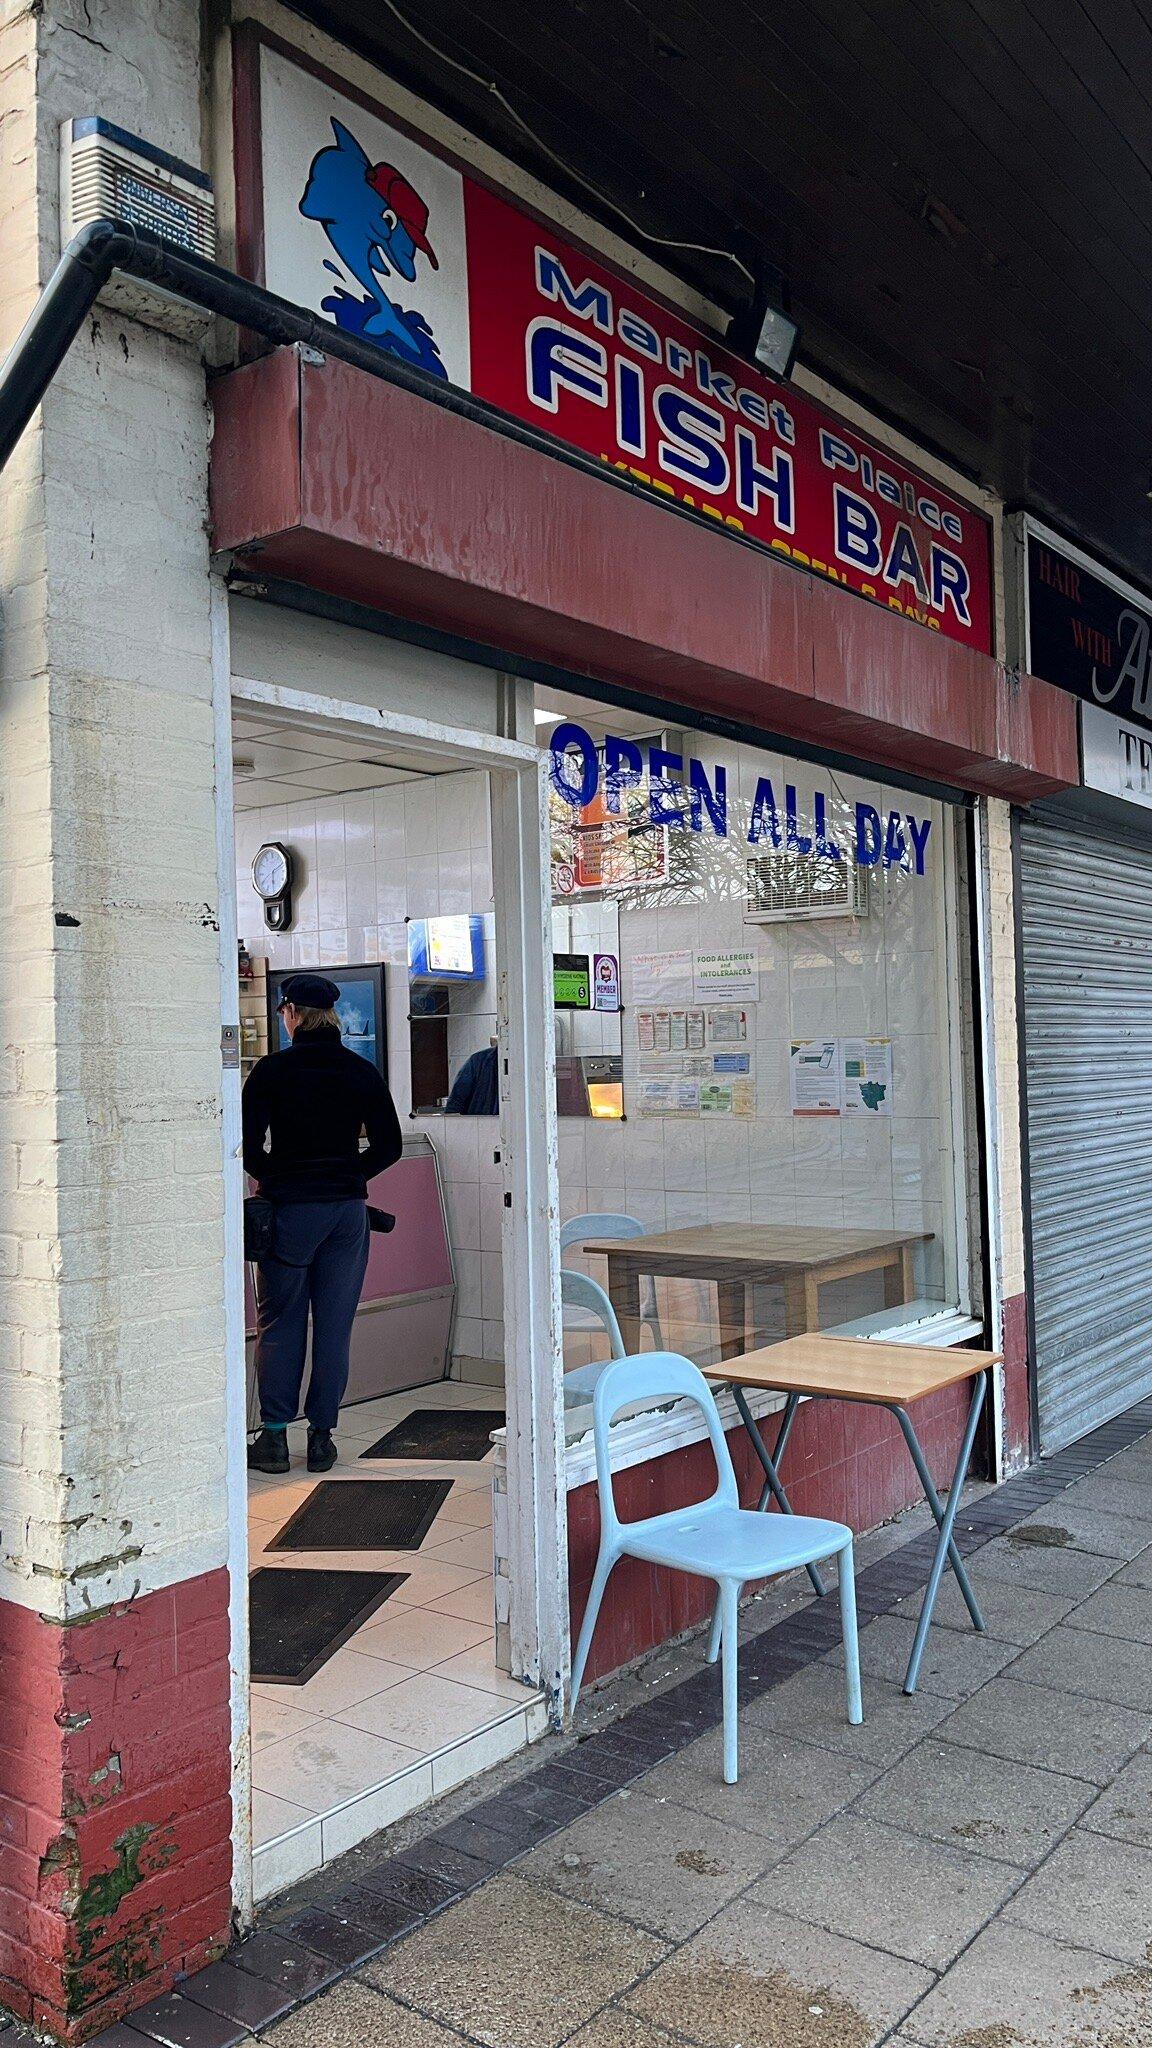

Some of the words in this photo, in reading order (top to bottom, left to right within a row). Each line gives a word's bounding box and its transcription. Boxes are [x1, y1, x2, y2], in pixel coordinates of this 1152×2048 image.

[535, 246, 794, 445] Market
[819, 428, 963, 543] Plaice
[525, 316, 795, 534] FISH
[833, 483, 972, 627] BAR
[1039, 550, 1081, 604] HAIR
[1070, 617, 1111, 668] WITH
[551, 723, 727, 838] OPEN
[747, 777, 841, 860] ALL
[855, 802, 932, 876] DAY
[700, 968, 751, 978] INTOLERANCES
[717, 953, 754, 961] ALLERGIES
[597, 985, 616, 993] MEMBER
